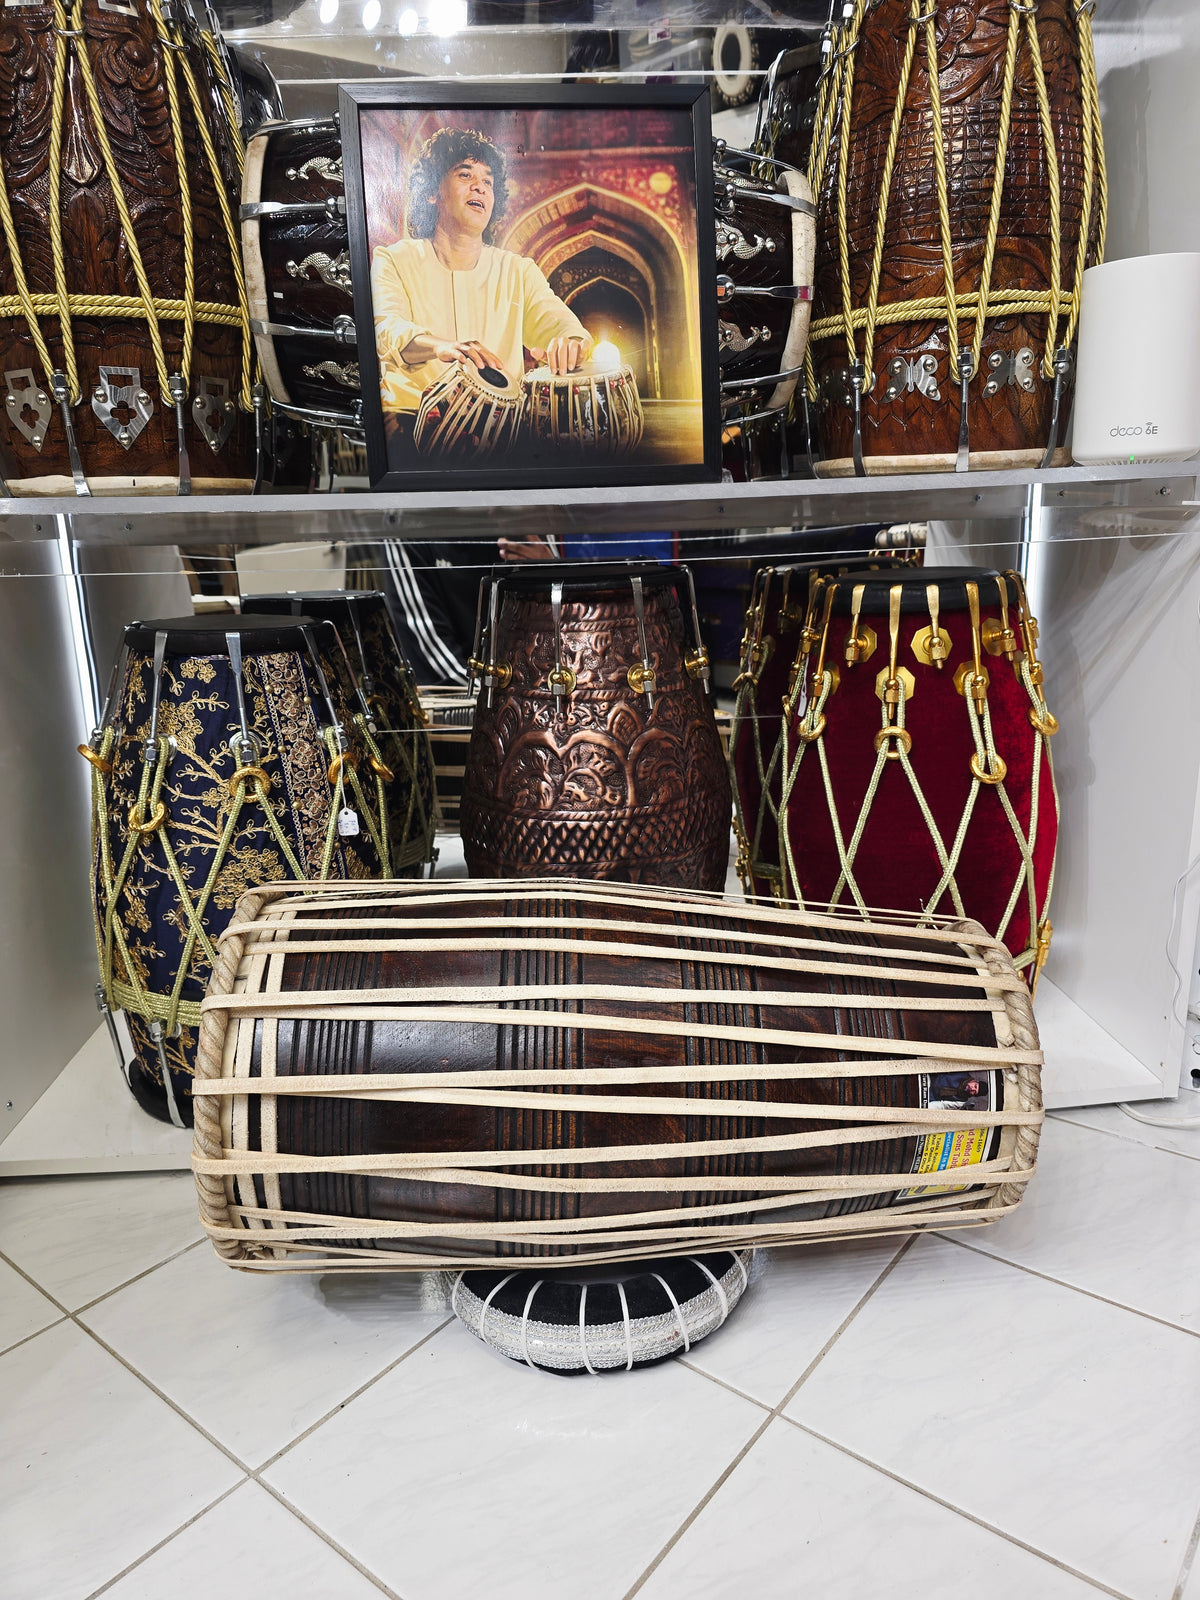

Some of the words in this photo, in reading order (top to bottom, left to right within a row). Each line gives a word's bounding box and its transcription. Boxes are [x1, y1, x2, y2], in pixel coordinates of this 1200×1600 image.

[1110, 425, 1143, 437] deco
[943, 1132, 952, 1156] pecialist
[955, 1134, 965, 1151] Sons
[964, 1138, 974, 1157] Mohd
